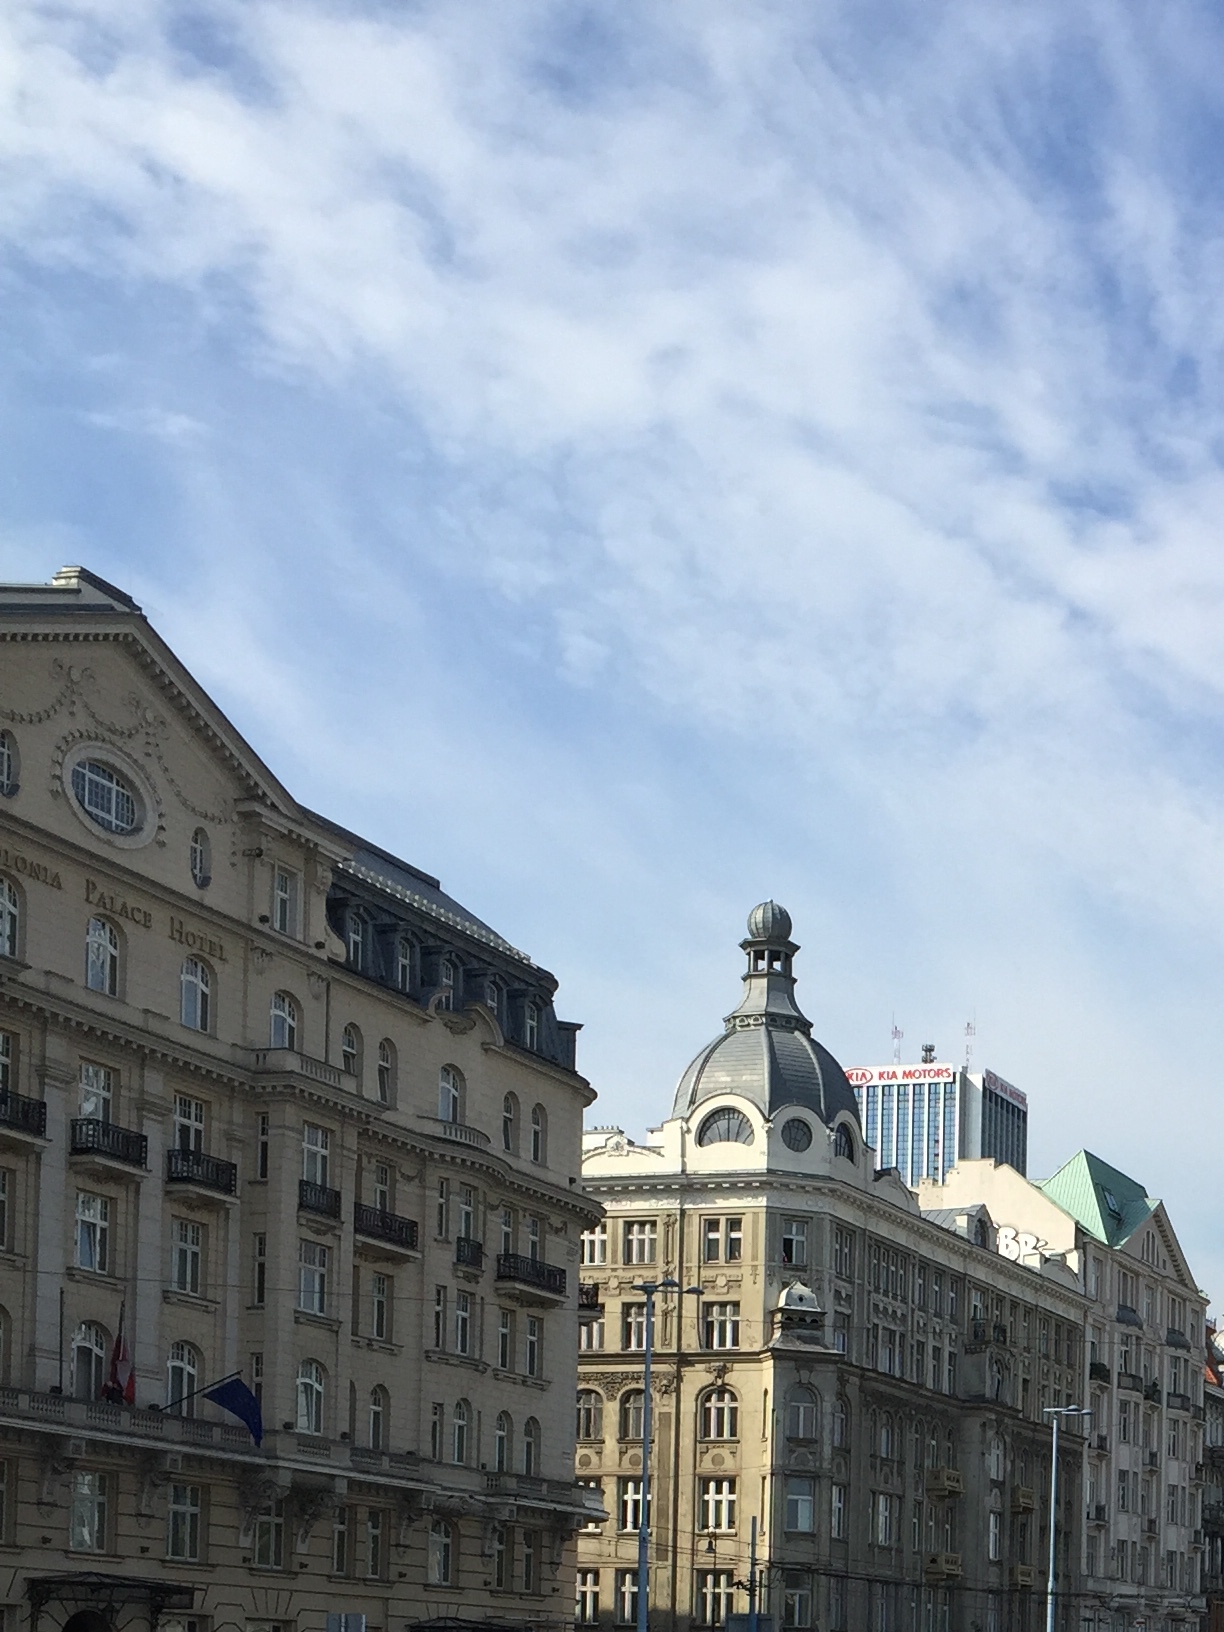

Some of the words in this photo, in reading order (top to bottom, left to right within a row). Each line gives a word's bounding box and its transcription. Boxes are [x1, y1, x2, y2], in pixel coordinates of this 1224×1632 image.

[0, 849, 63, 890] LONIA
[878, 1071, 898, 1081] KIA
[902, 1068, 951, 1079] MOTORS
